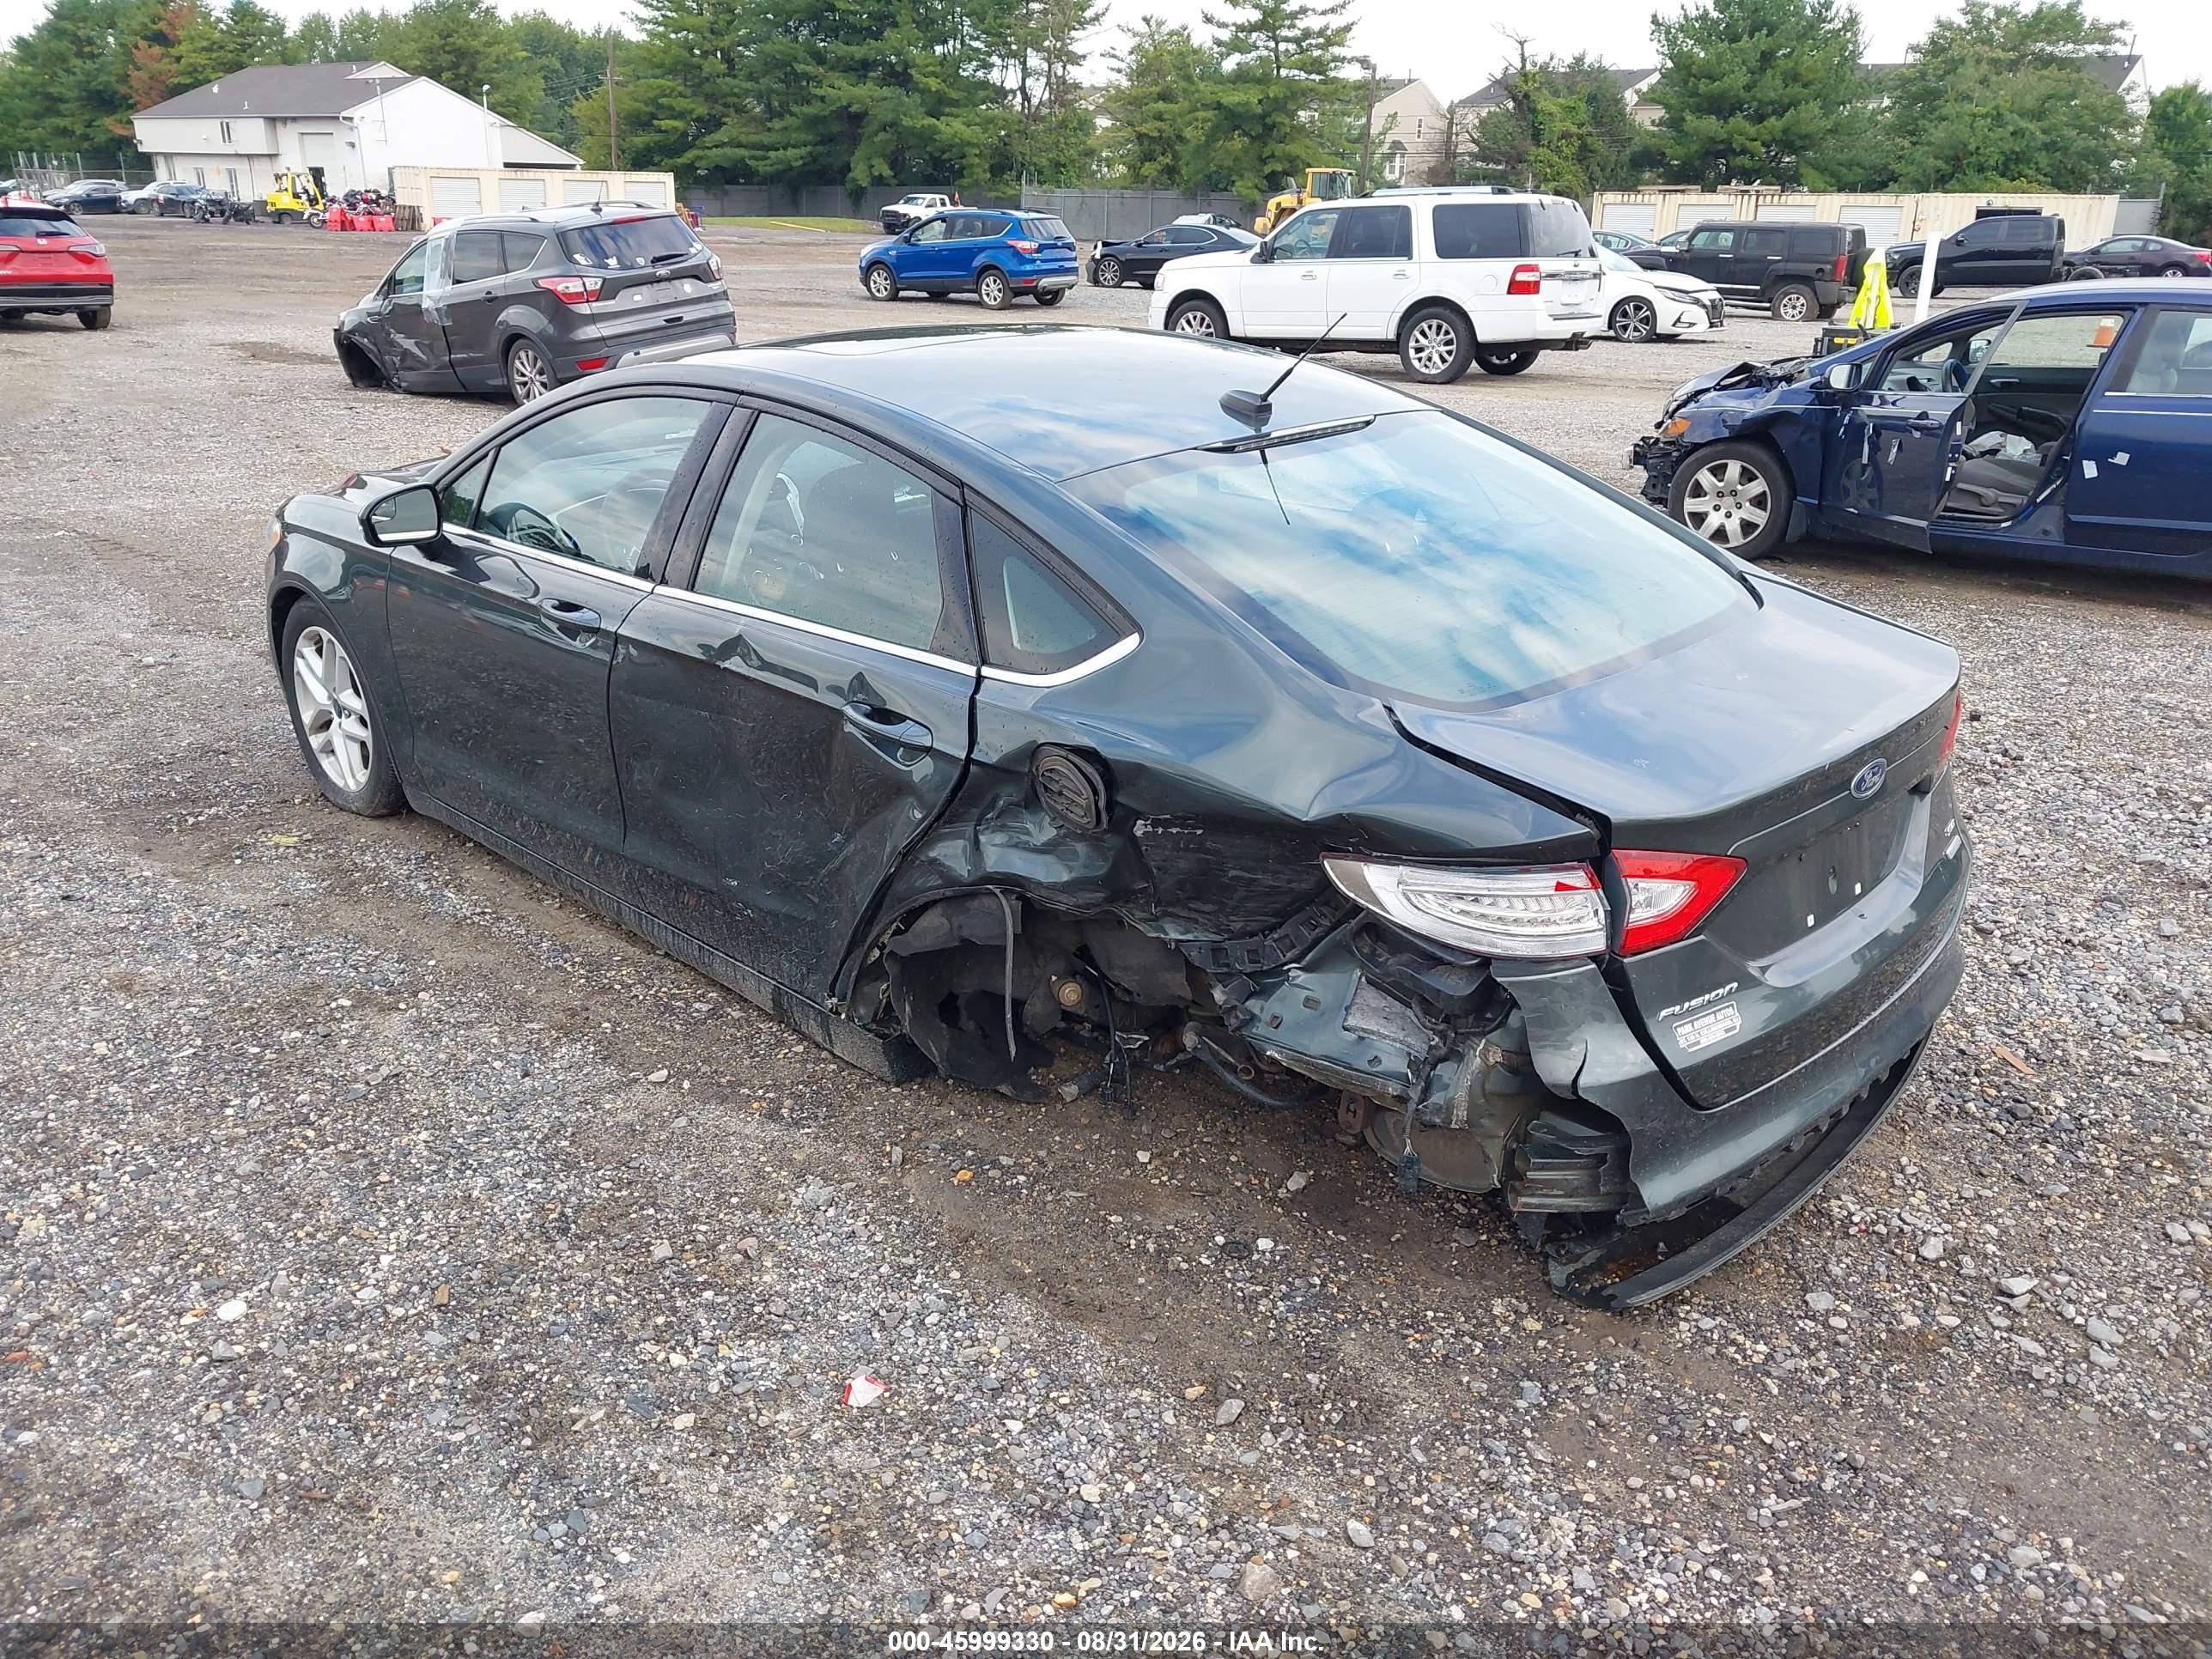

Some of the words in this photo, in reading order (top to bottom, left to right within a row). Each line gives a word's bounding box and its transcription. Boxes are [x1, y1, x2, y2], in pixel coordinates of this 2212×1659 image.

[1676, 1022, 1695, 1036] PARK
[1693, 1013, 1717, 1032] AVENUE
[1716, 1006, 1735, 1022] AUTOS
